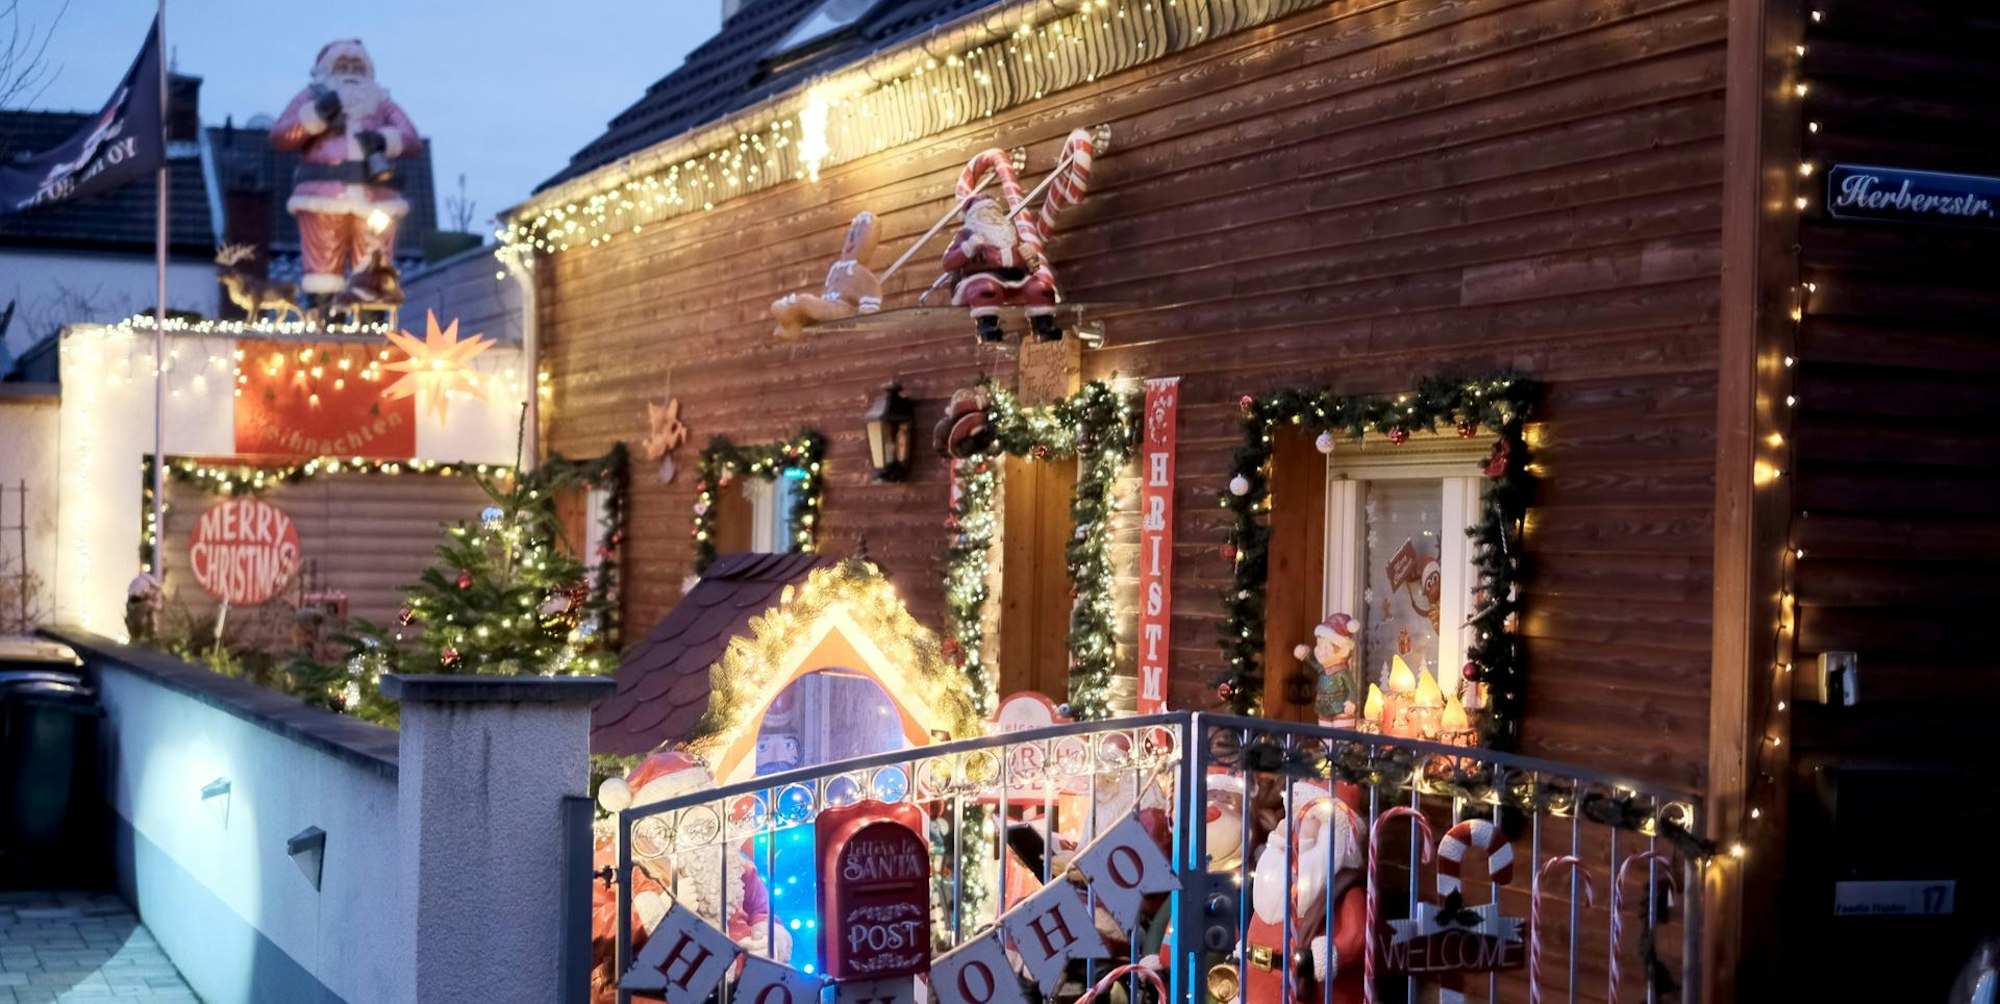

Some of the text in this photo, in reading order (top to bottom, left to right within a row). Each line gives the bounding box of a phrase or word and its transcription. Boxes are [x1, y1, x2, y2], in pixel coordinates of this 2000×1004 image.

[200, 499, 291, 548] MERRY
[1142, 394, 1174, 715] CHRISTM
[843, 854, 923, 880] SANTA
[1922, 886, 1947, 913] 17
[848, 920, 921, 953] POST
[1379, 930, 1524, 971] WELCOME
